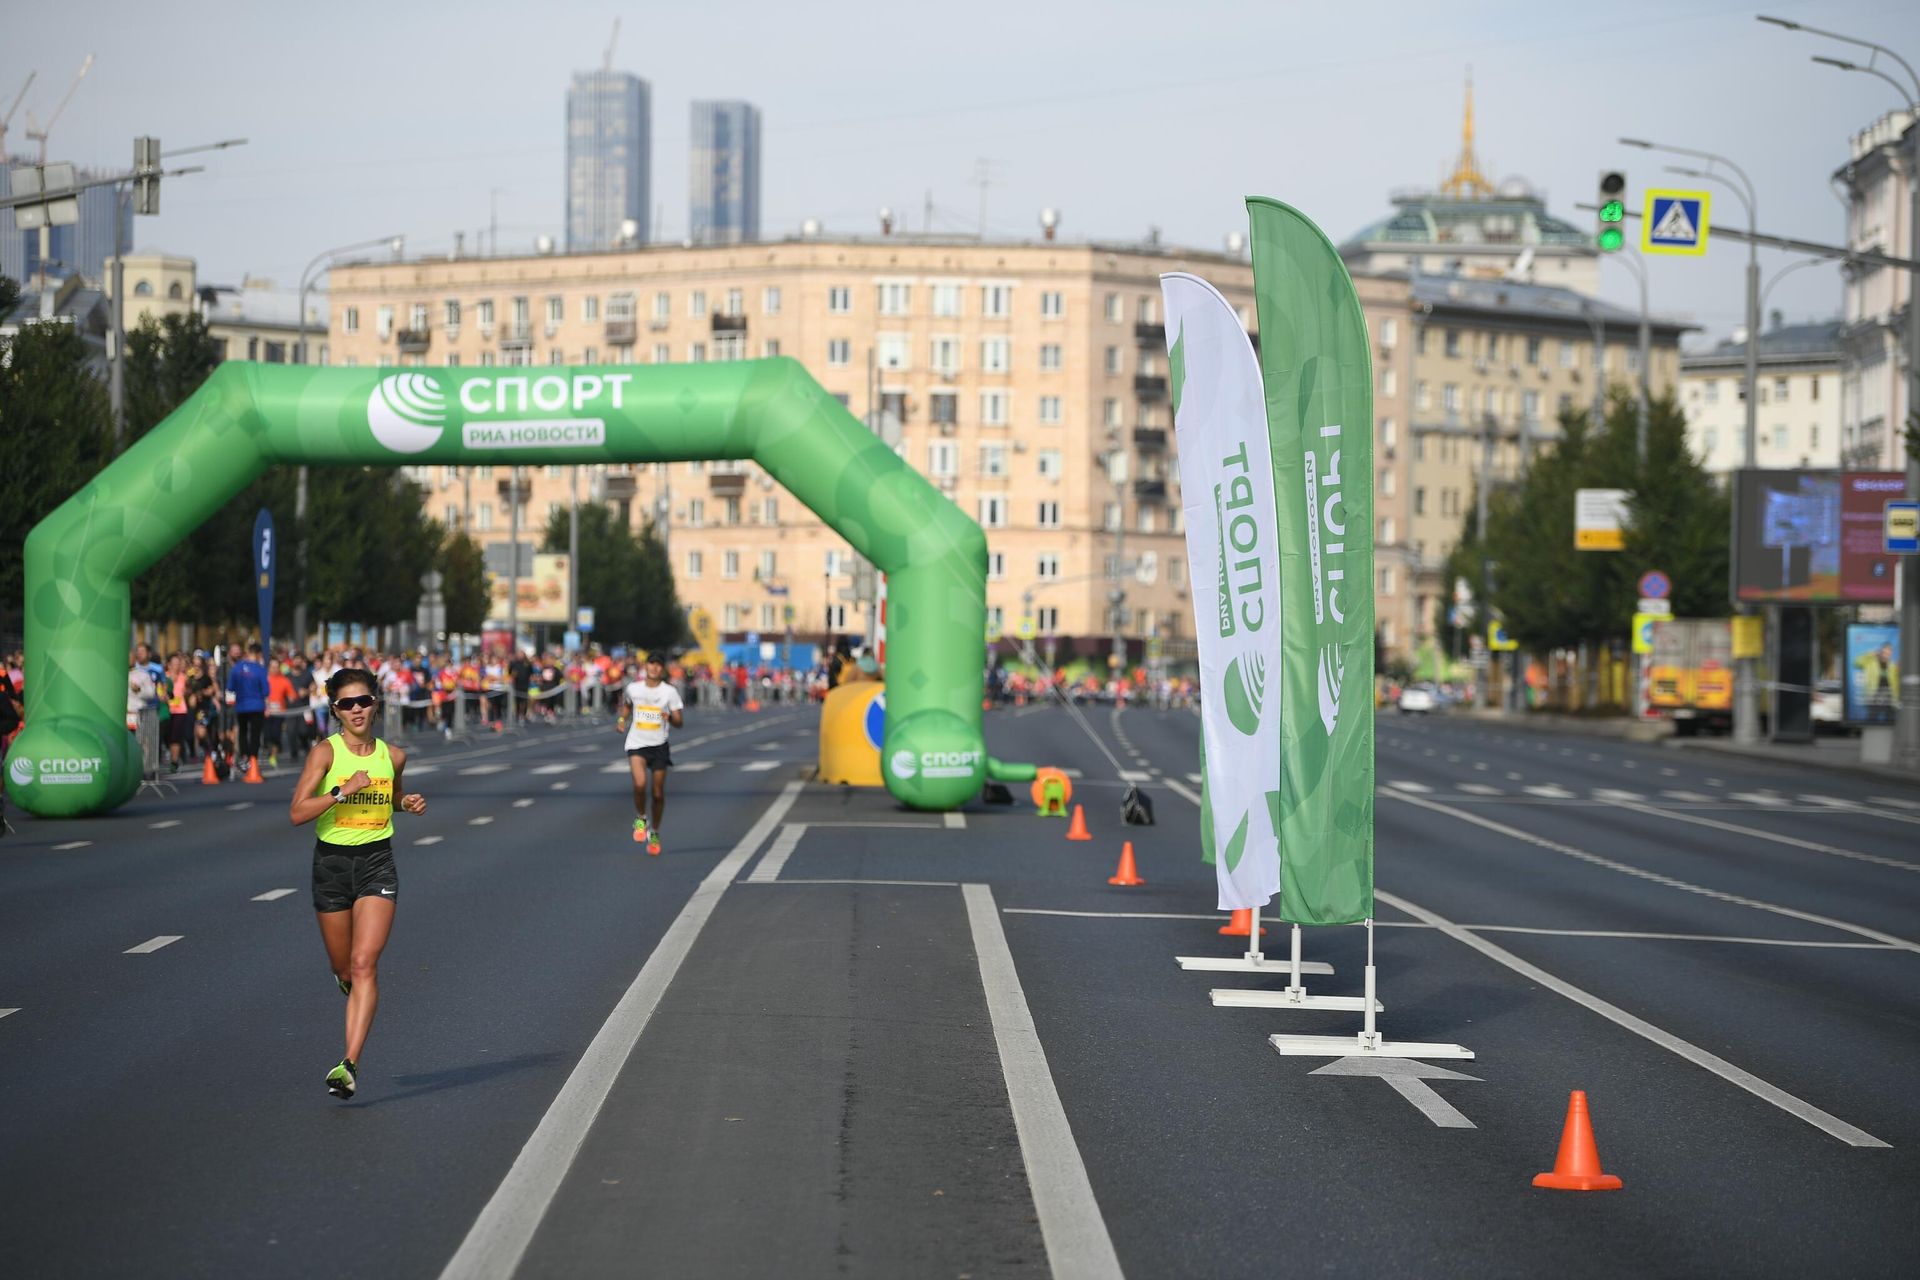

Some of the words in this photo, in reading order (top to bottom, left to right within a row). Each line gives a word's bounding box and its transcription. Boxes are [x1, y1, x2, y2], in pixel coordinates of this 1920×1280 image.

[459, 374, 632, 413] СПОРТ
[470, 428, 506, 443] РИА
[510, 427, 598, 442] НОВОСТИ
[40, 758, 101, 773] СПОРТ
[921, 750, 981, 766] СПОРТ
